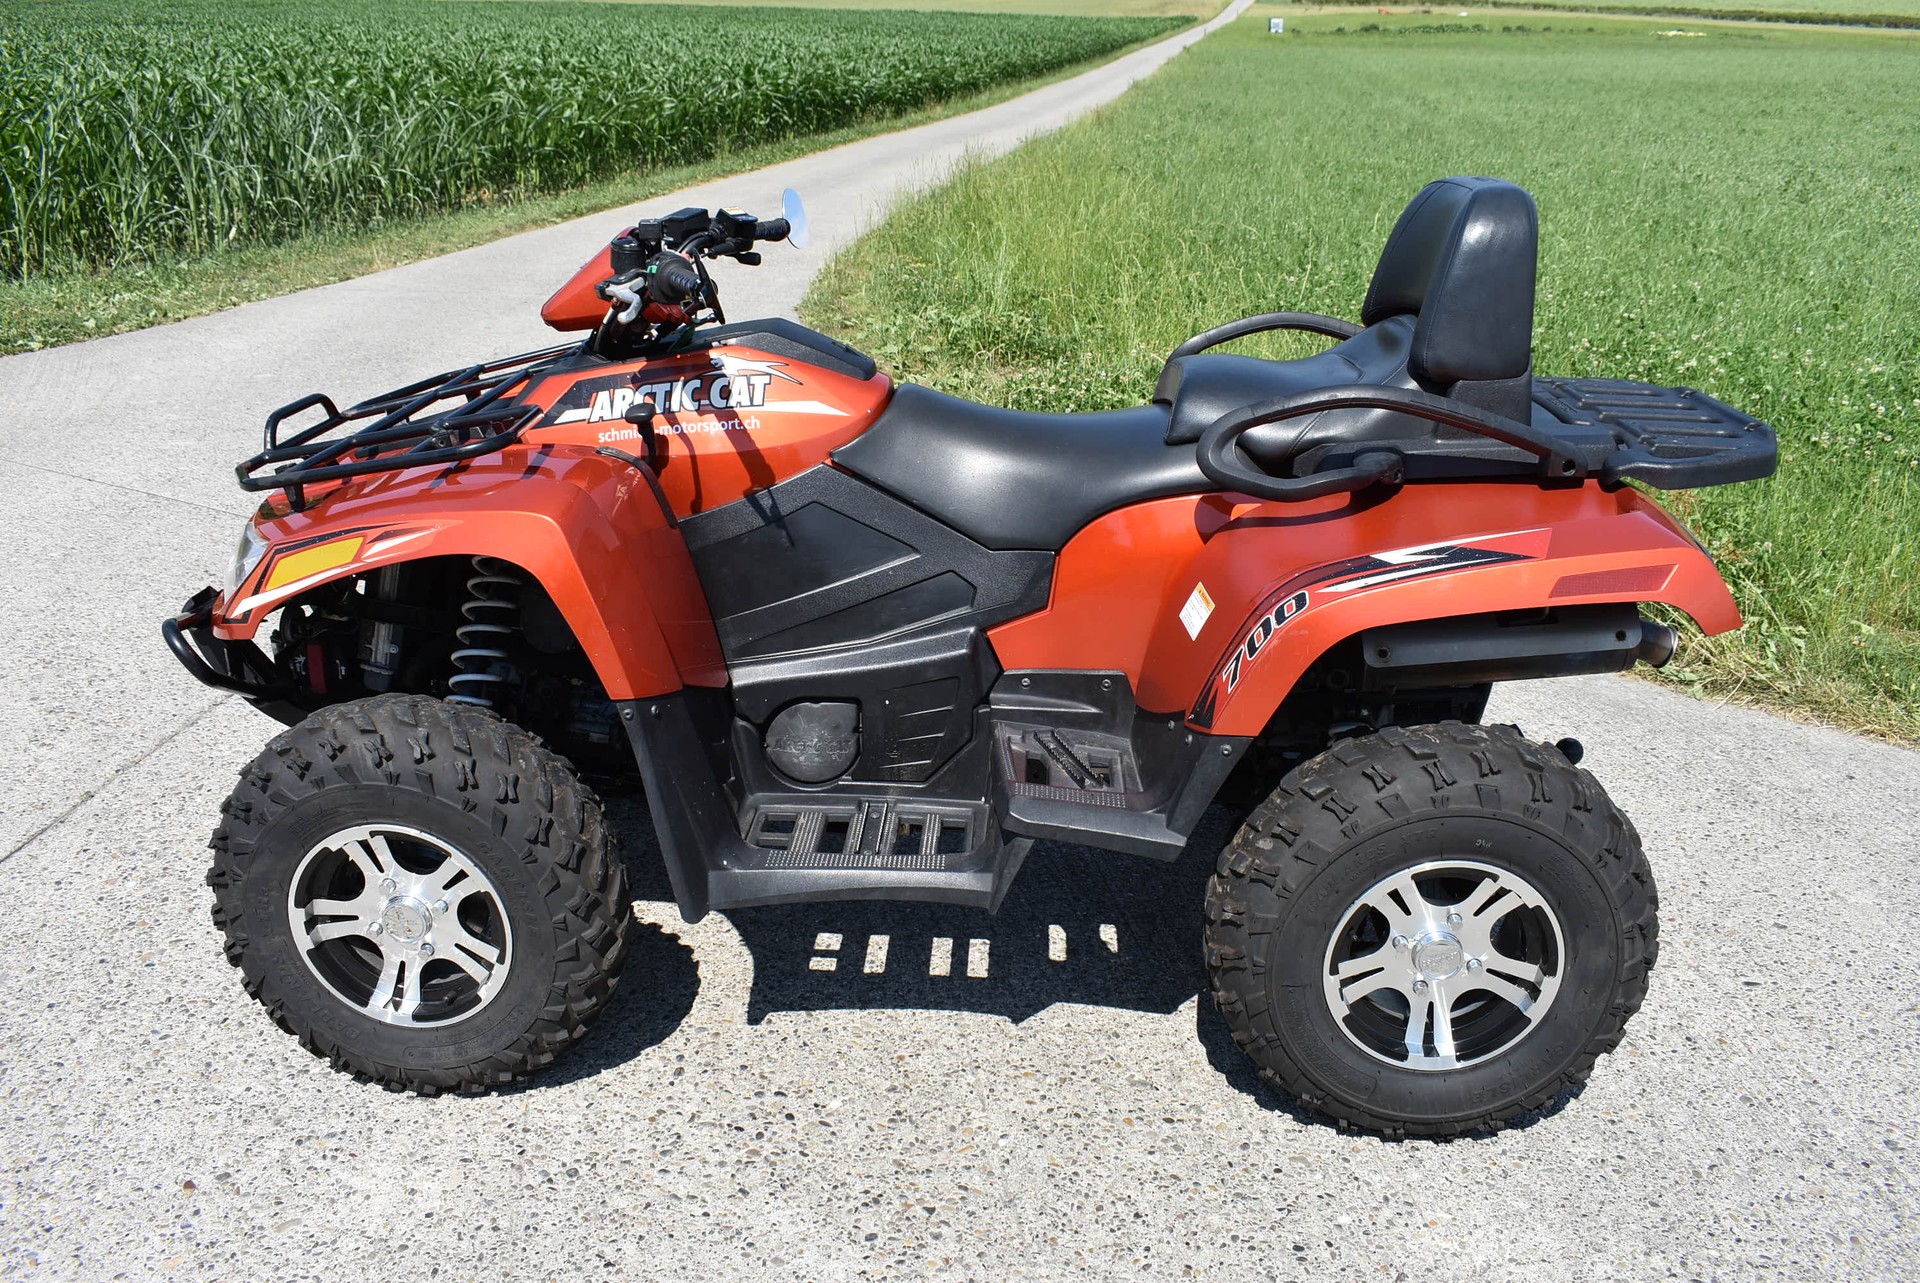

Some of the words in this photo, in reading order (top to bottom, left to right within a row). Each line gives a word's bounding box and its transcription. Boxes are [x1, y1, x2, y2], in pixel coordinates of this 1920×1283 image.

[709, 373, 771, 410] CAT
[598, 416, 761, 442] schmi-motorsport.ch
[1222, 590, 1309, 694] 700
